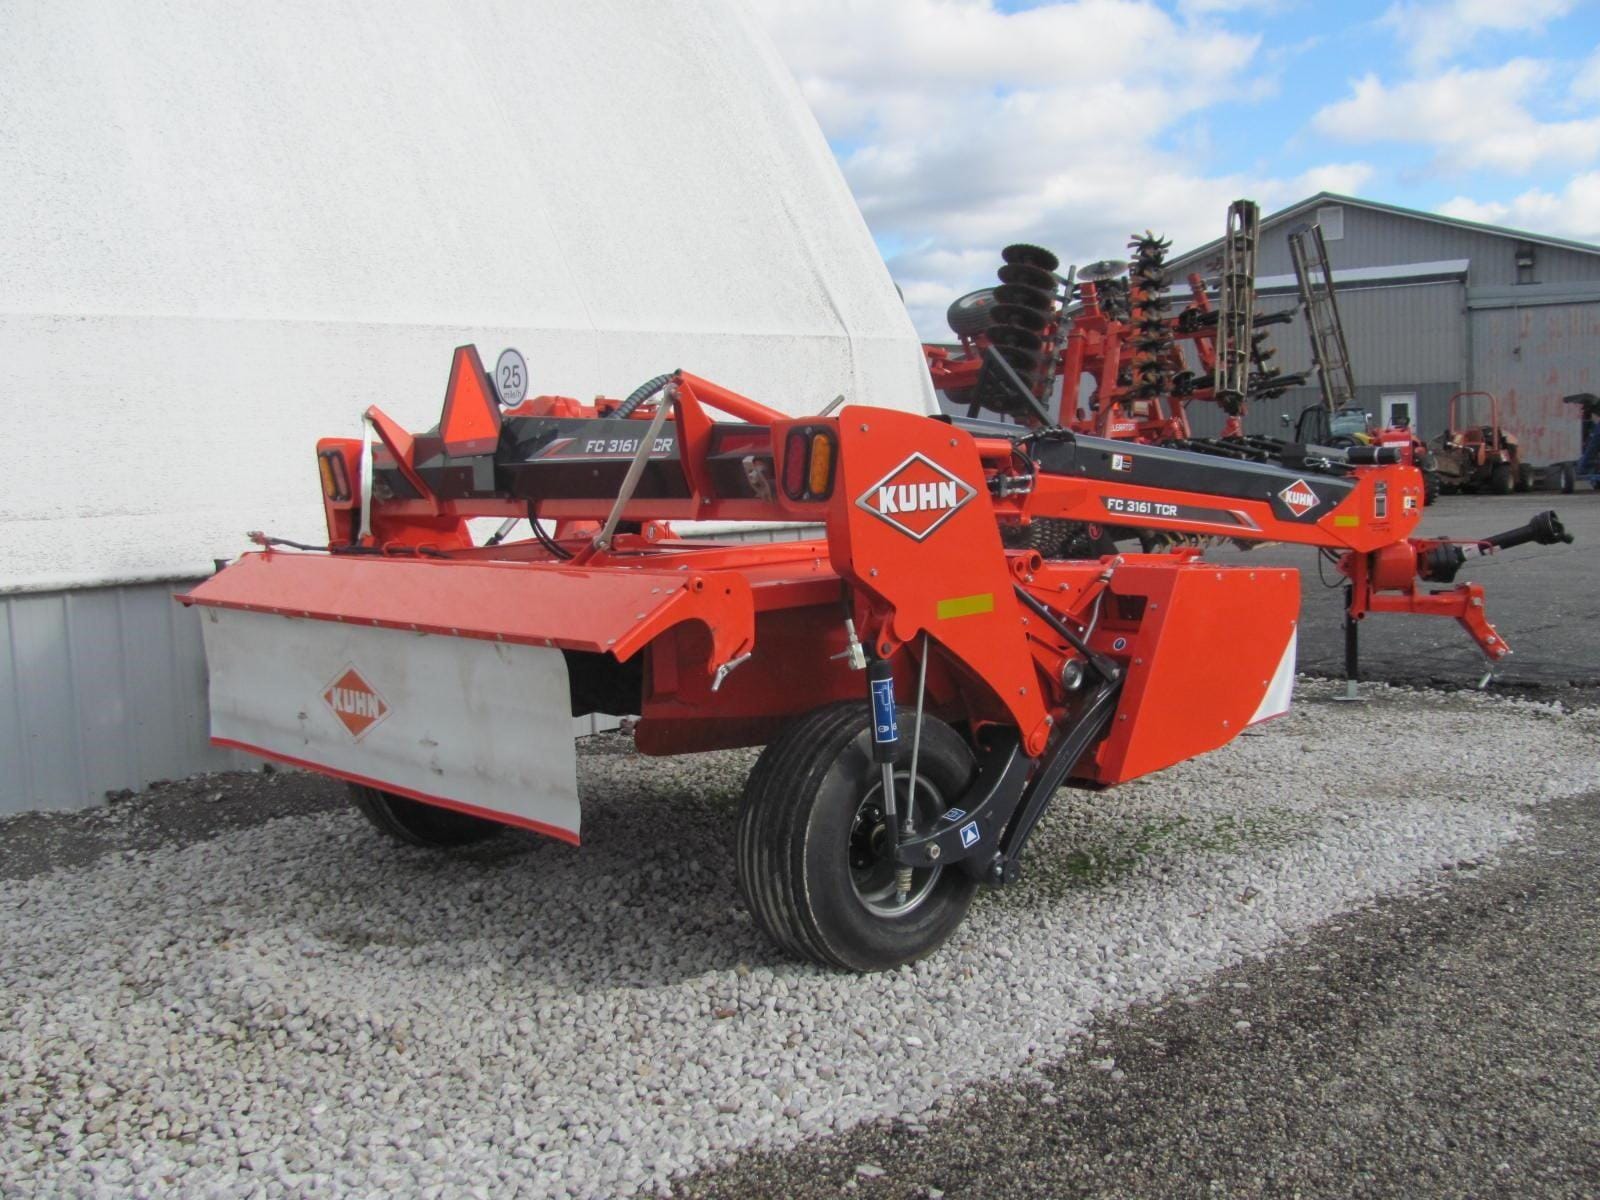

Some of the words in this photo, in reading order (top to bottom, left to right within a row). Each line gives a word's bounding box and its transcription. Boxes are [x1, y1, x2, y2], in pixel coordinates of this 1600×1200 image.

[502, 364, 521, 389] 25
[585, 439, 605, 453] FC
[607, 439, 639, 453] 3161
[651, 438, 674, 452] CR
[879, 481, 957, 514] KUHN
[1107, 498, 1124, 511] FC
[1127, 500, 1151, 514] 3161
[1154, 503, 1177, 516] TCR
[1285, 490, 1314, 507] KUHN
[332, 686, 380, 720] KUHN
